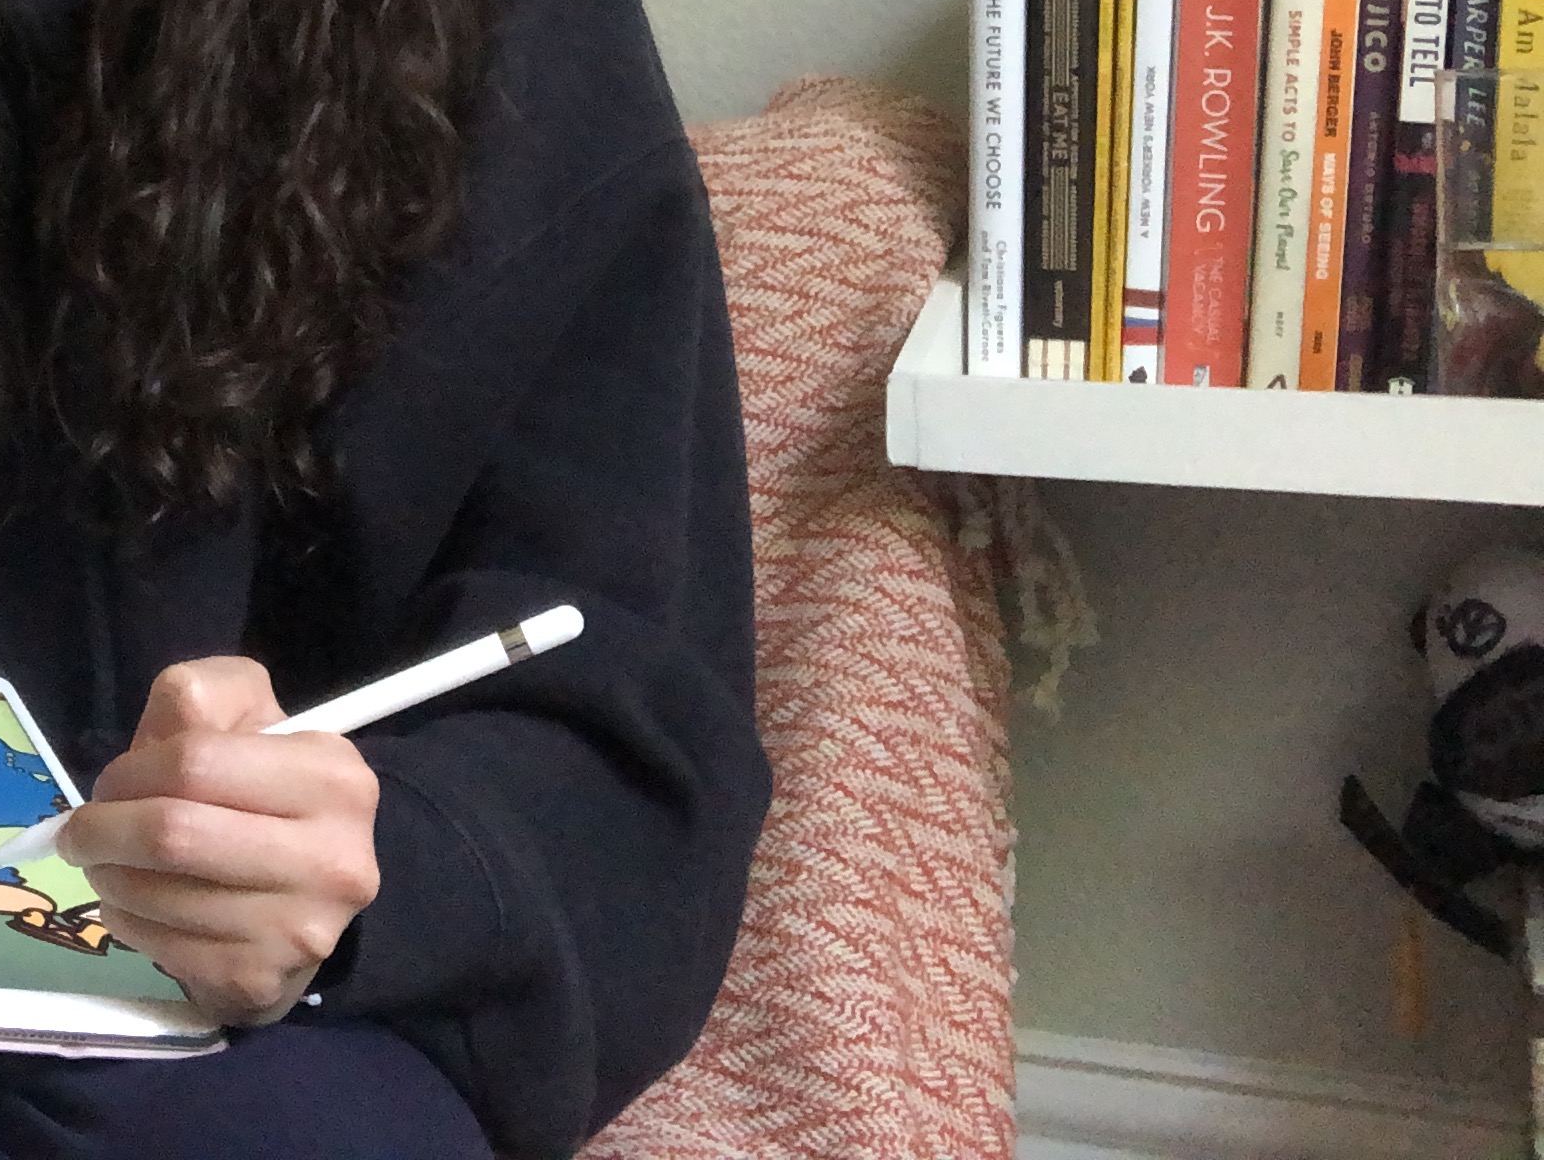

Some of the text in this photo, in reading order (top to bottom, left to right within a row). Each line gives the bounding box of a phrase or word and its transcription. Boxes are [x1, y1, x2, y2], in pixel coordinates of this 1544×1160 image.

[1286, 10, 1303, 67] SIMPLE
[1328, 28, 1343, 70] JOHN
[1516, 8, 1544, 54] Am
[985, 26, 1002, 91] FUTURE
[1409, 36, 1440, 87] TELL
[1144, 66, 1156, 98] YORK
[1283, 73, 1298, 115] ACTS
[985, 97, 1002, 126] WE
[1052, 92, 1070, 160] EAT ME
[1143, 103, 1154, 131] NEW
[1196, 5, 1234, 233] J.K. ROWLING
[1324, 74, 1341, 137] BERGER
[1467, 87, 1487, 127] LEE
[1281, 122, 1297, 143] TO
[985, 133, 1002, 210] CHOOSE
[1140, 199, 1151, 227] NEW
[1320, 197, 1335, 218] OF
[1140, 230, 1150, 239] A
